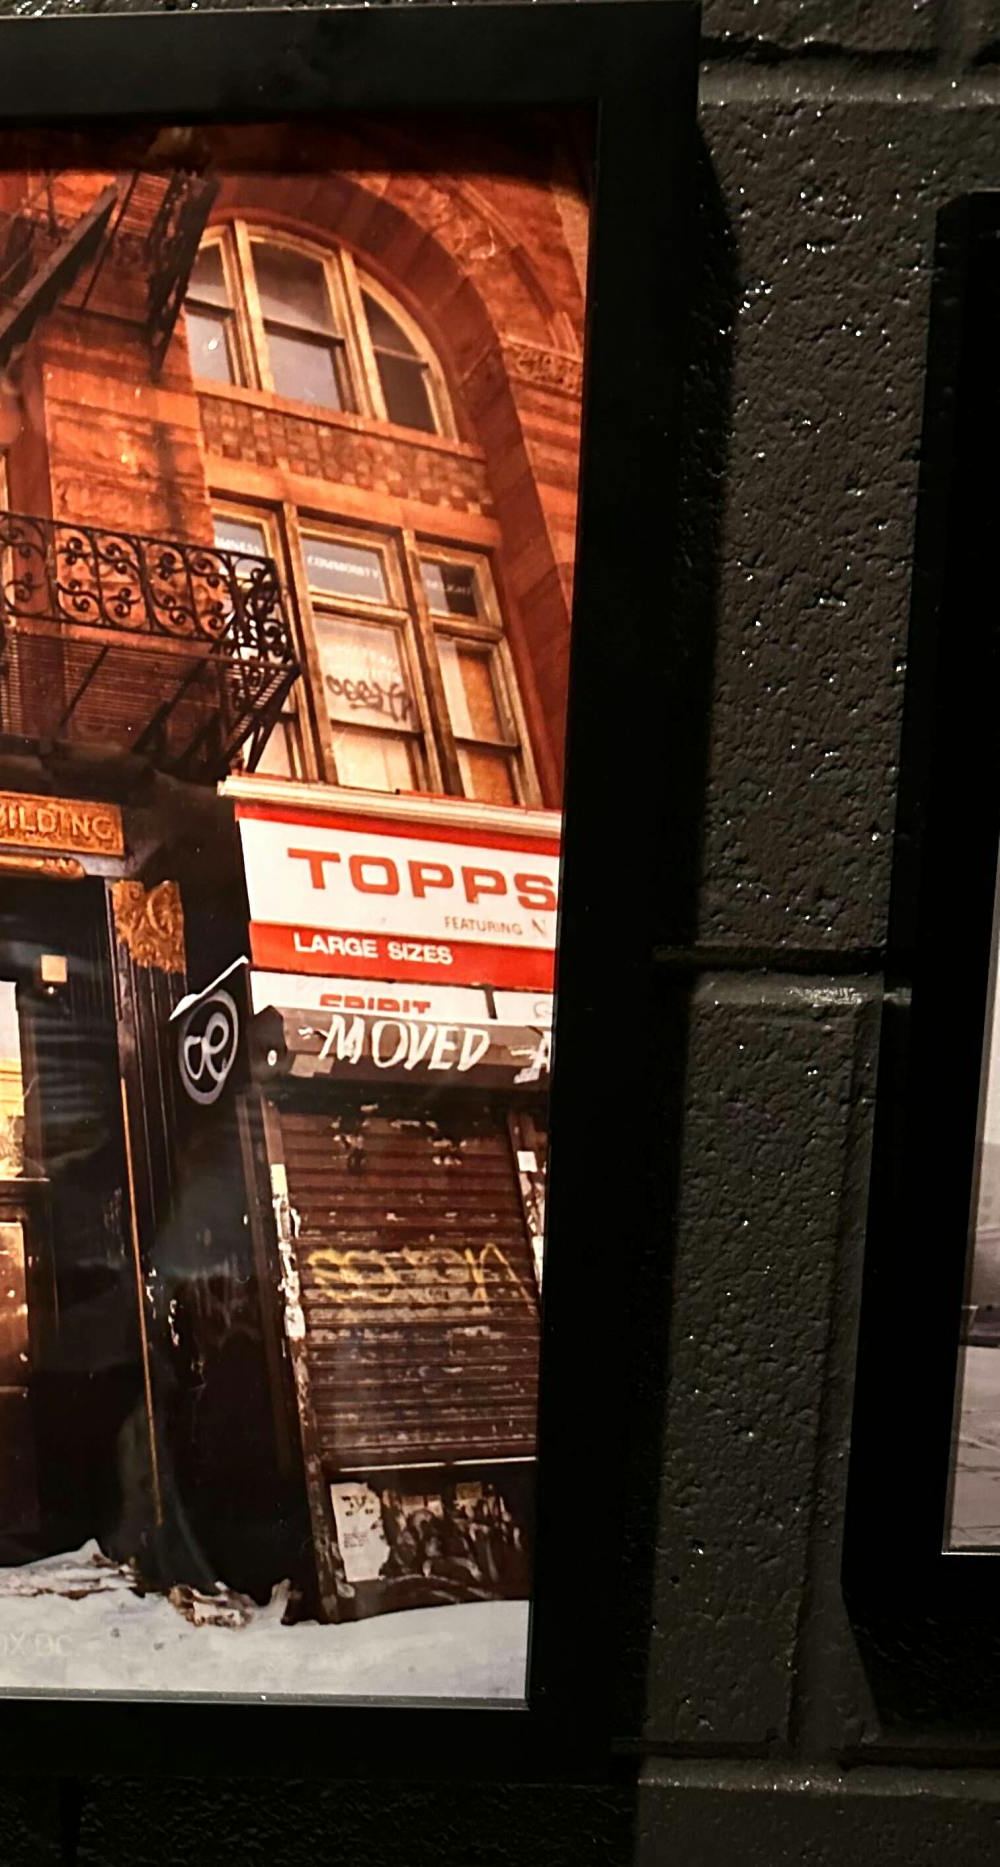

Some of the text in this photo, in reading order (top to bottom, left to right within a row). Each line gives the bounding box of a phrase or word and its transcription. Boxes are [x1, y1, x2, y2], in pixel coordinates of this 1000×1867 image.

[286, 847, 556, 911] TOPPS
[294, 932, 454, 965] LARGE SIZES
[444, 916, 524, 936] FEATURING
[317, 1014, 490, 1072] MOVED
